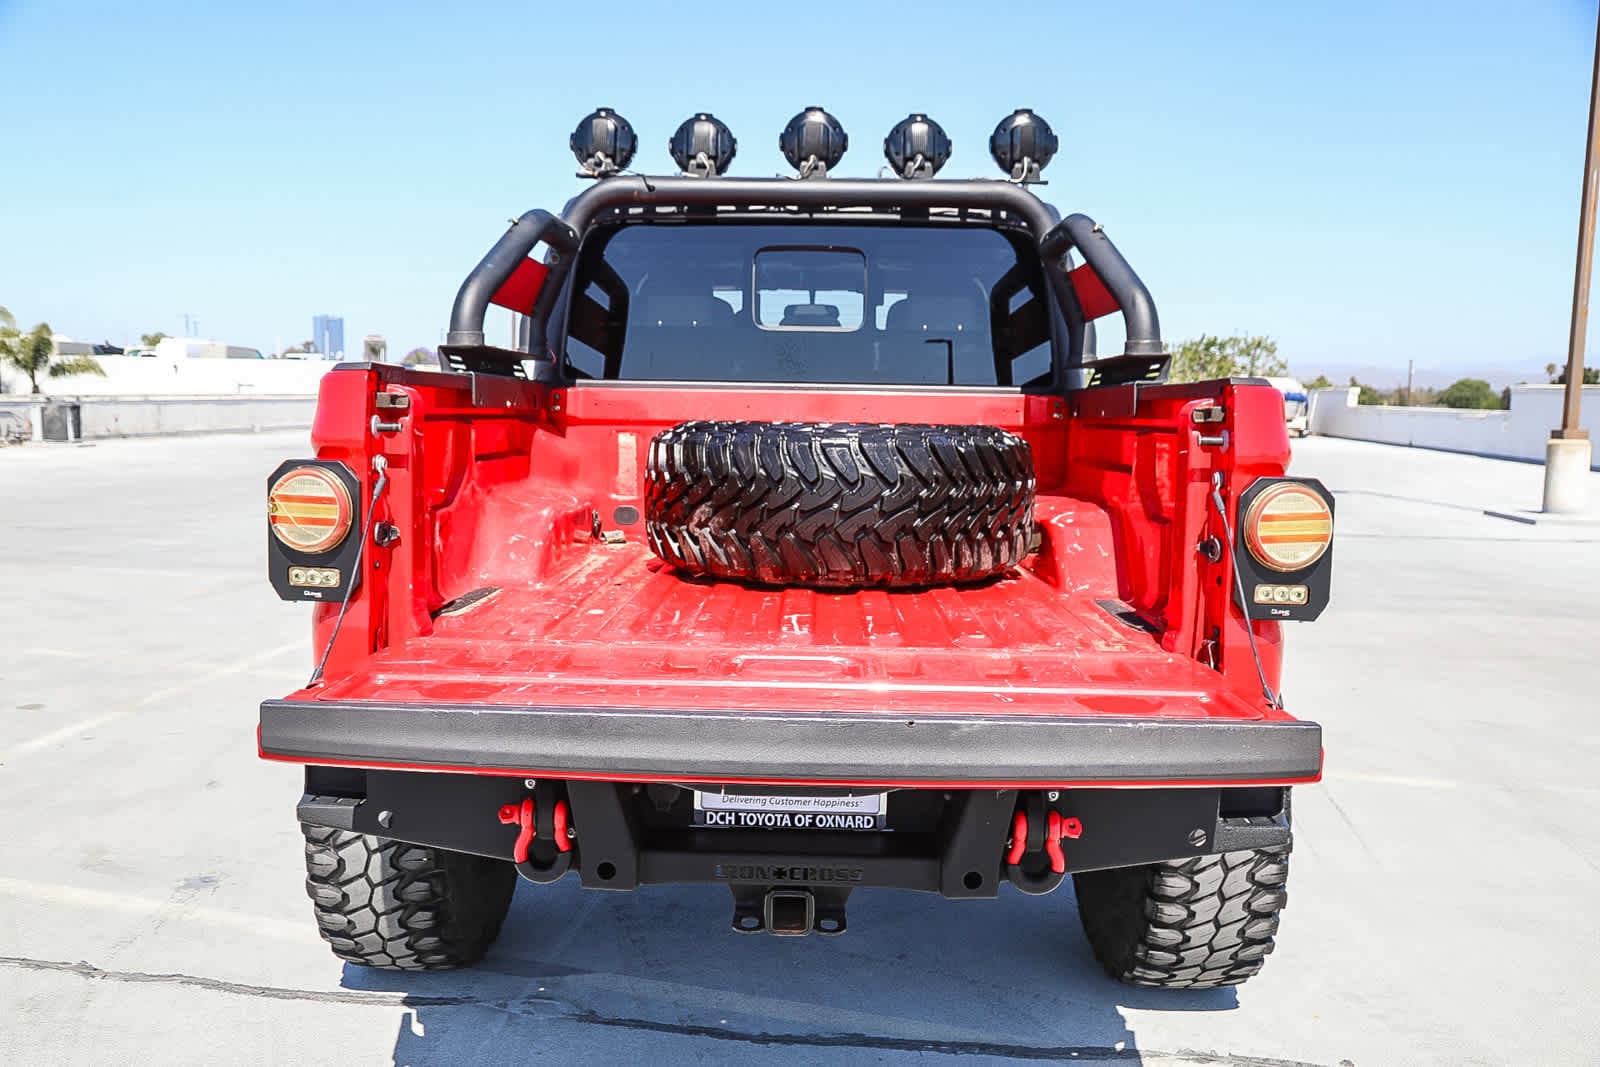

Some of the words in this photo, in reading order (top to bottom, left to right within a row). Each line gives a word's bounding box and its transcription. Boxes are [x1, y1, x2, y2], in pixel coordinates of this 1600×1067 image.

[722, 795, 767, 807] Delivering
[768, 797, 811, 806] Customer
[706, 811, 735, 825] DCH
[738, 812, 792, 827] TOYOTA
[794, 814, 813, 827] OF
[815, 815, 874, 829] OXNARD
[715, 864, 769, 880] IRON
[789, 866, 863, 882] CROSS
